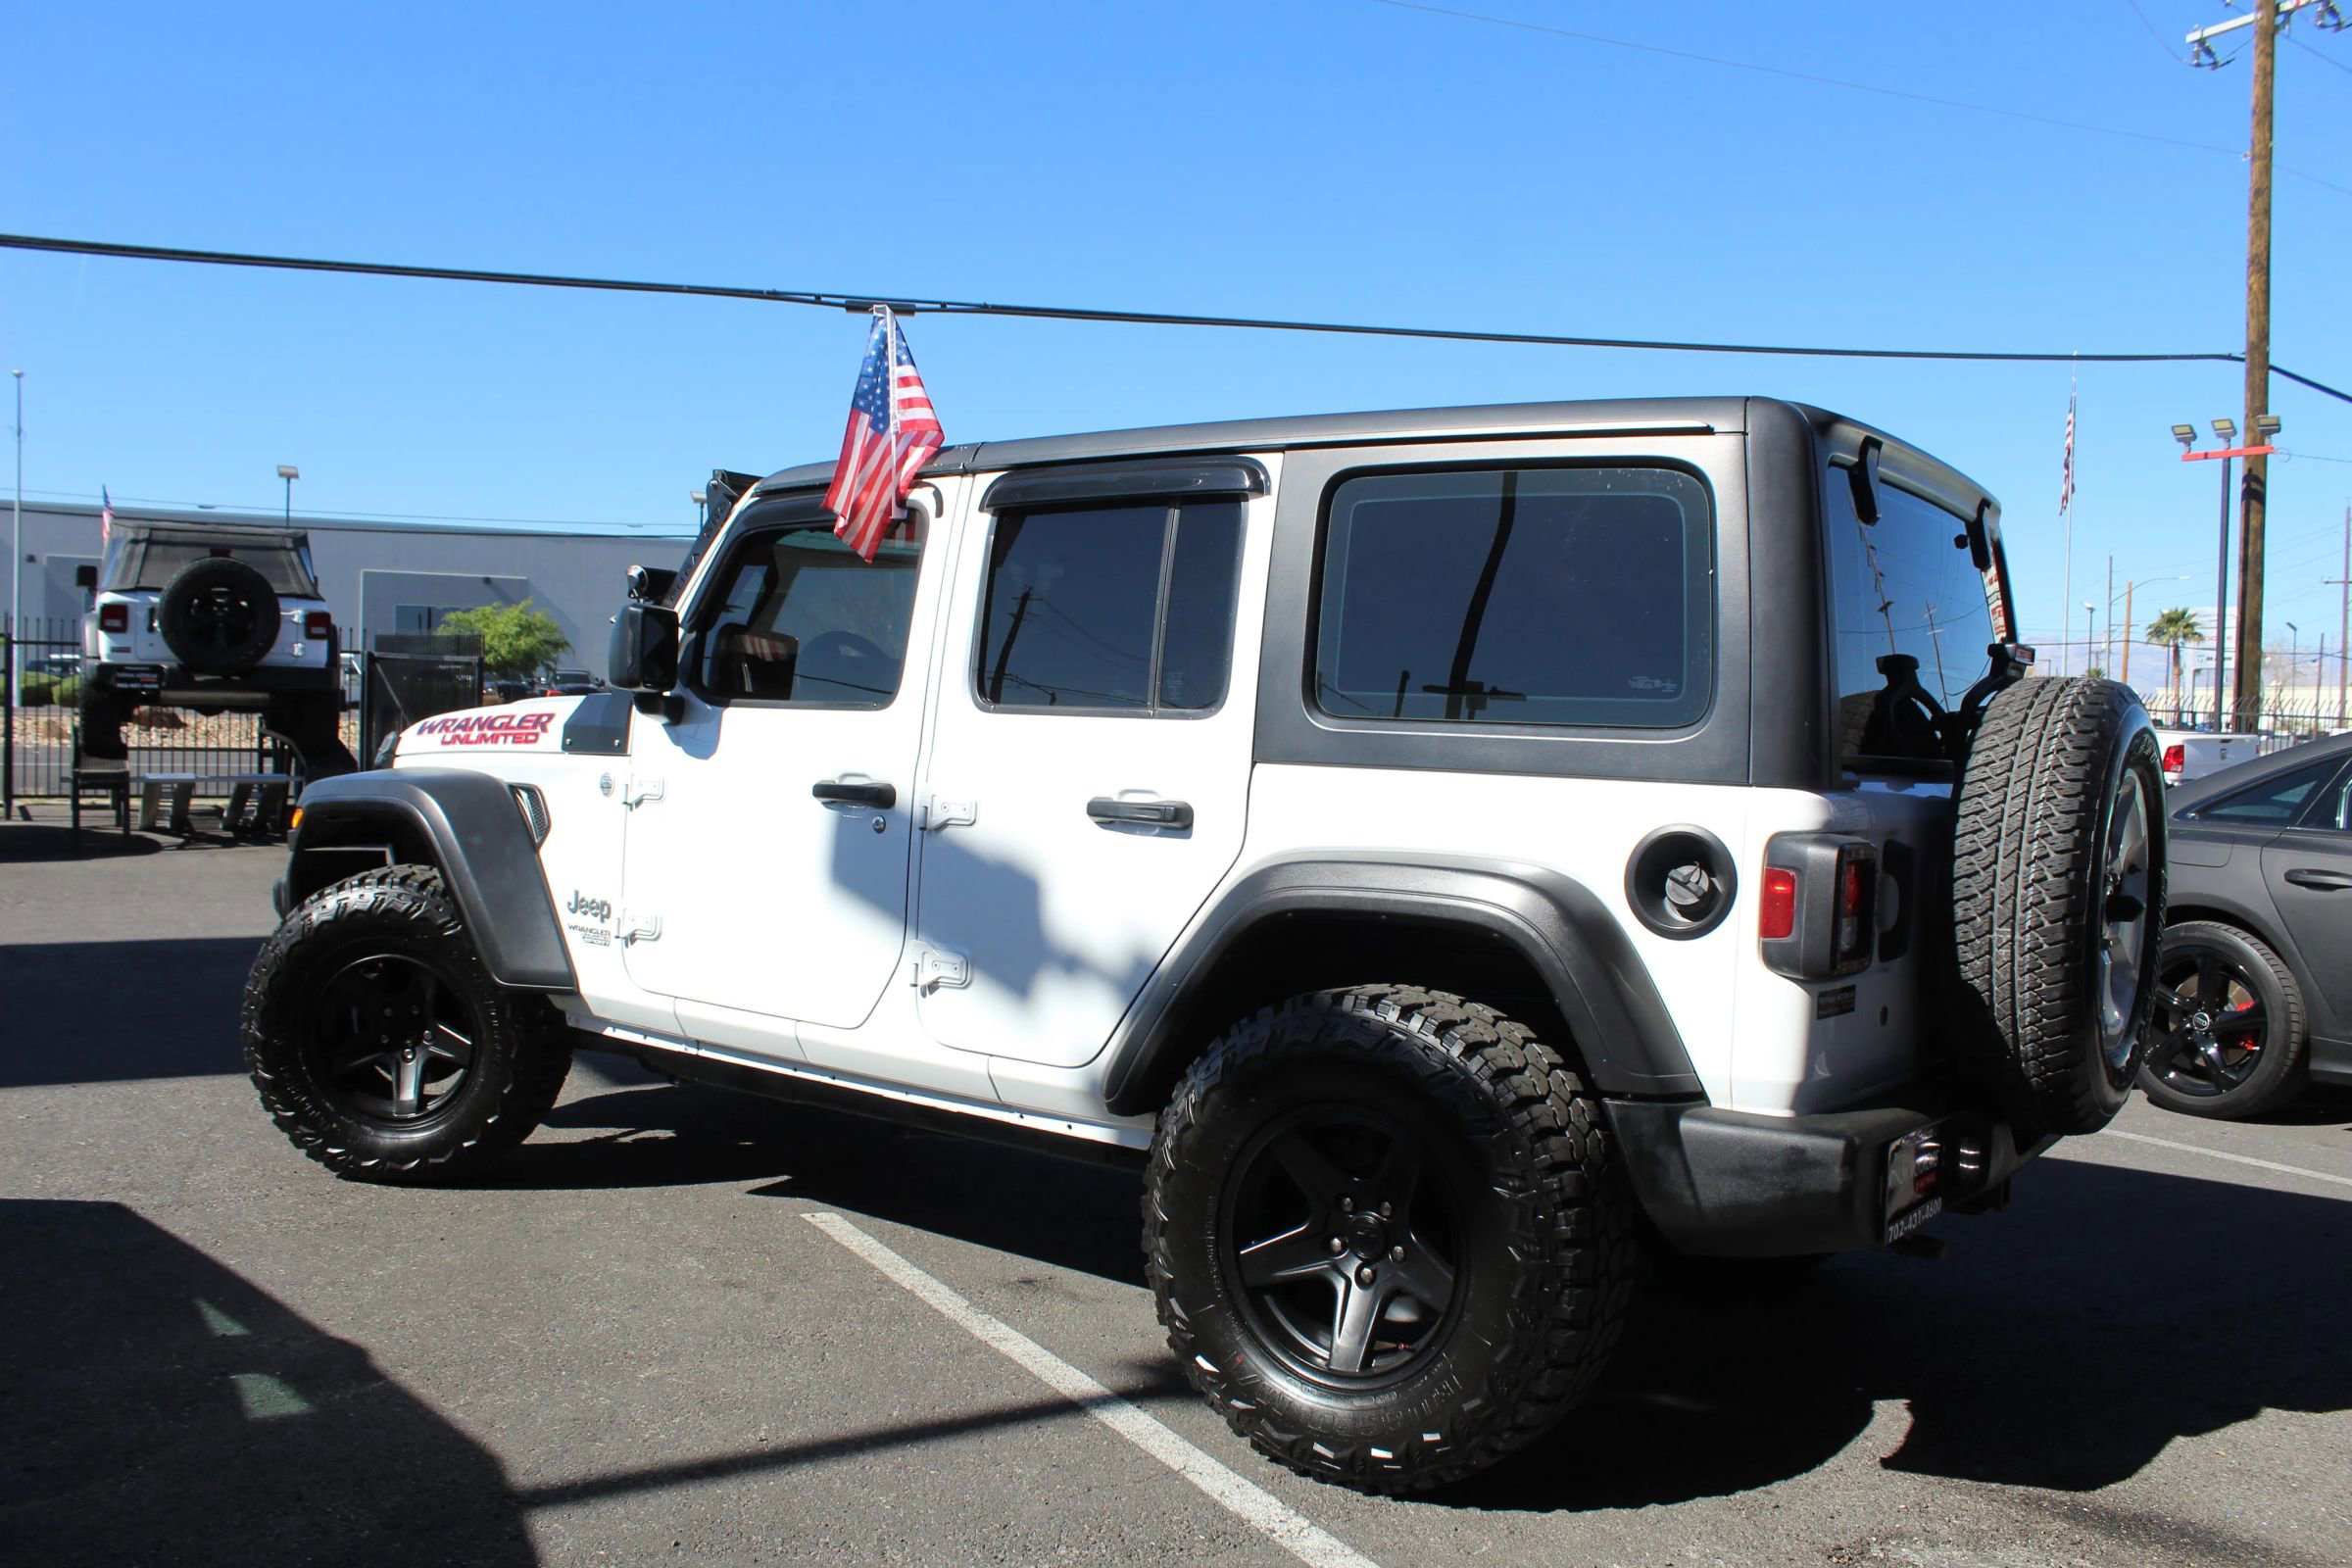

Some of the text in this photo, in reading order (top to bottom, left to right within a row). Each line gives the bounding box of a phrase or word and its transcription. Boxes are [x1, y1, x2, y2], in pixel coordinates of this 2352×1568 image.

[416, 712, 555, 735] WRANGLER
[442, 732, 540, 746] UNLIMITED
[568, 890, 612, 923] Jeep
[568, 924, 611, 937] WRANGLER
